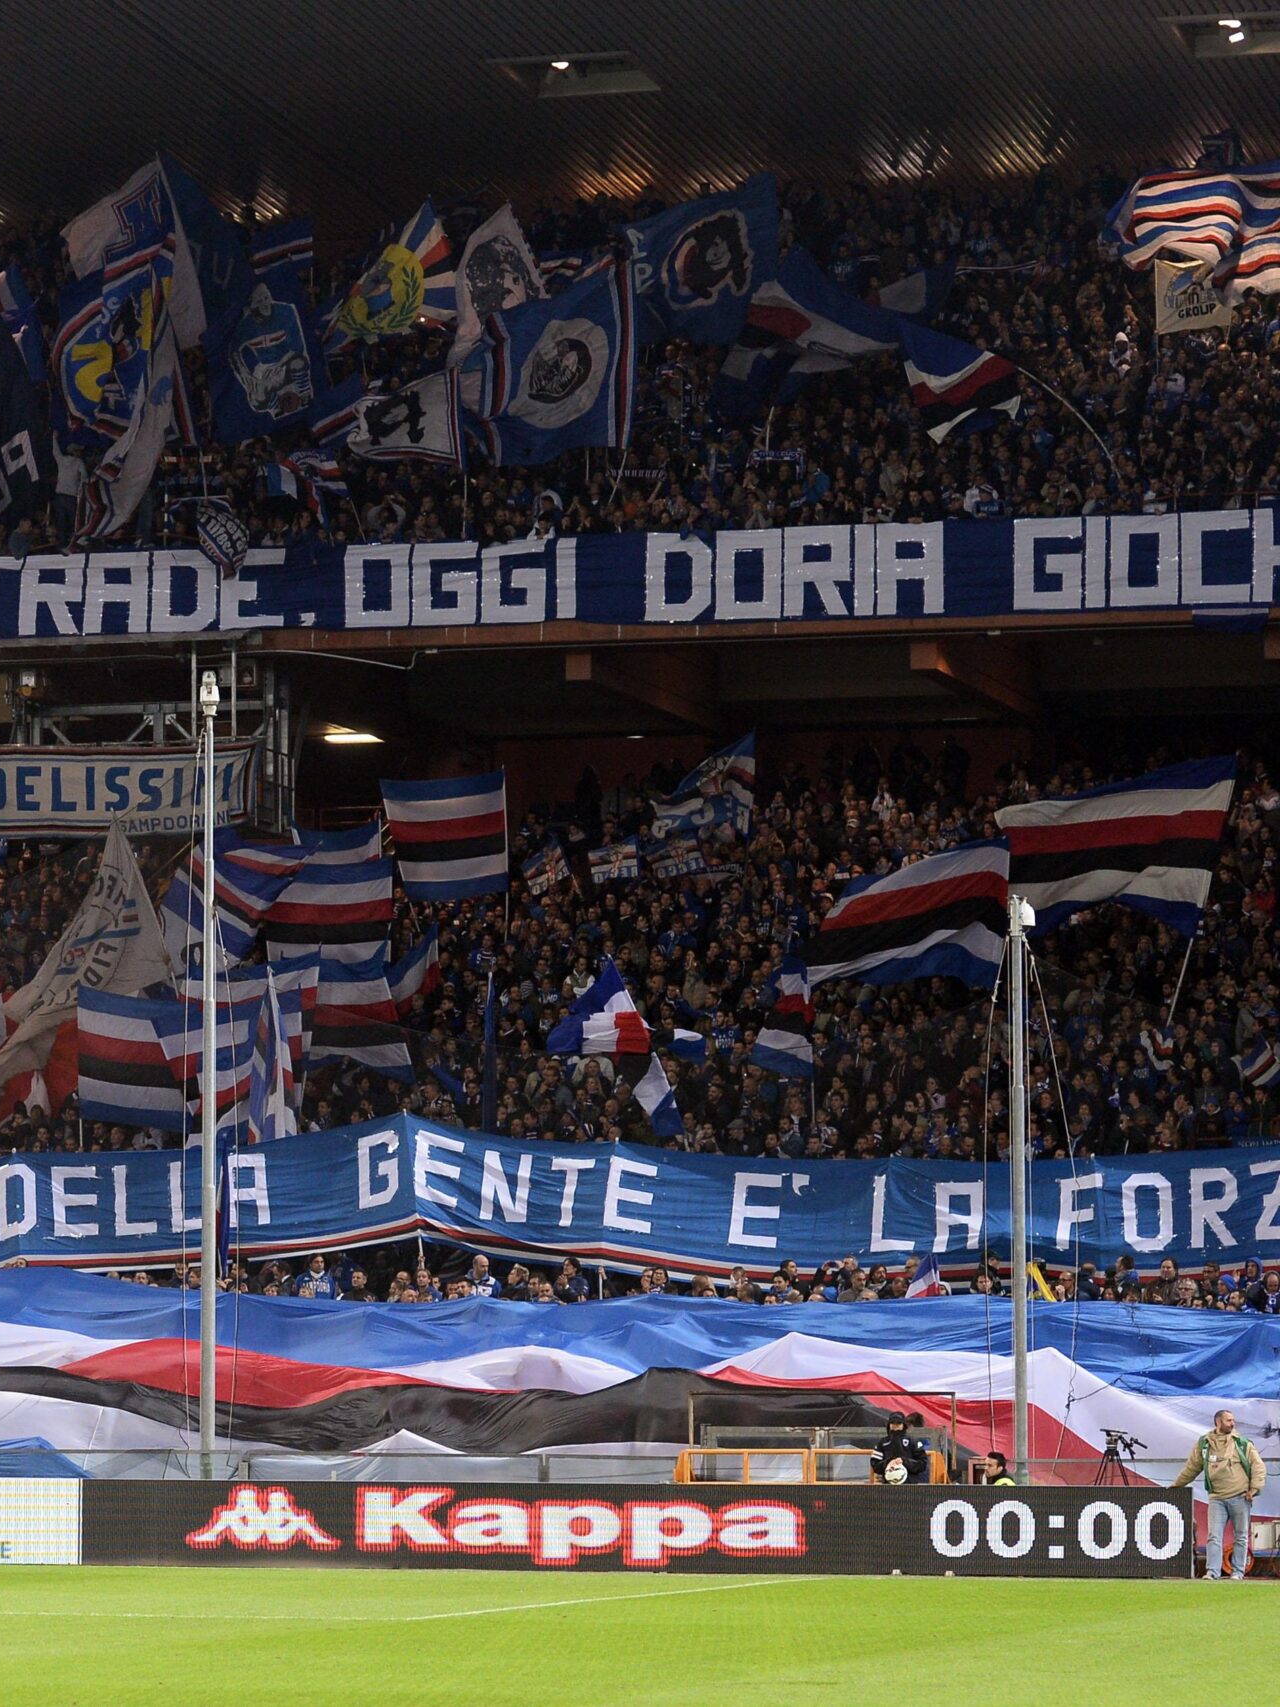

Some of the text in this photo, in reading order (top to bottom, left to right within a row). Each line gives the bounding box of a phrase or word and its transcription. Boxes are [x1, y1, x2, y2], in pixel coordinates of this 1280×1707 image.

[1177, 302, 1217, 319] GROUP
[344, 537, 577, 629] OGGI
[644, 520, 945, 623] DORIA
[120, 808, 234, 834] SAMPDORINI
[359, 1130, 658, 1235] GENTE
[727, 1172, 810, 1249] E'
[871, 1174, 983, 1252] LA
[357, 1487, 807, 1566] Kappa
[930, 1499, 1186, 1560] 00:00
